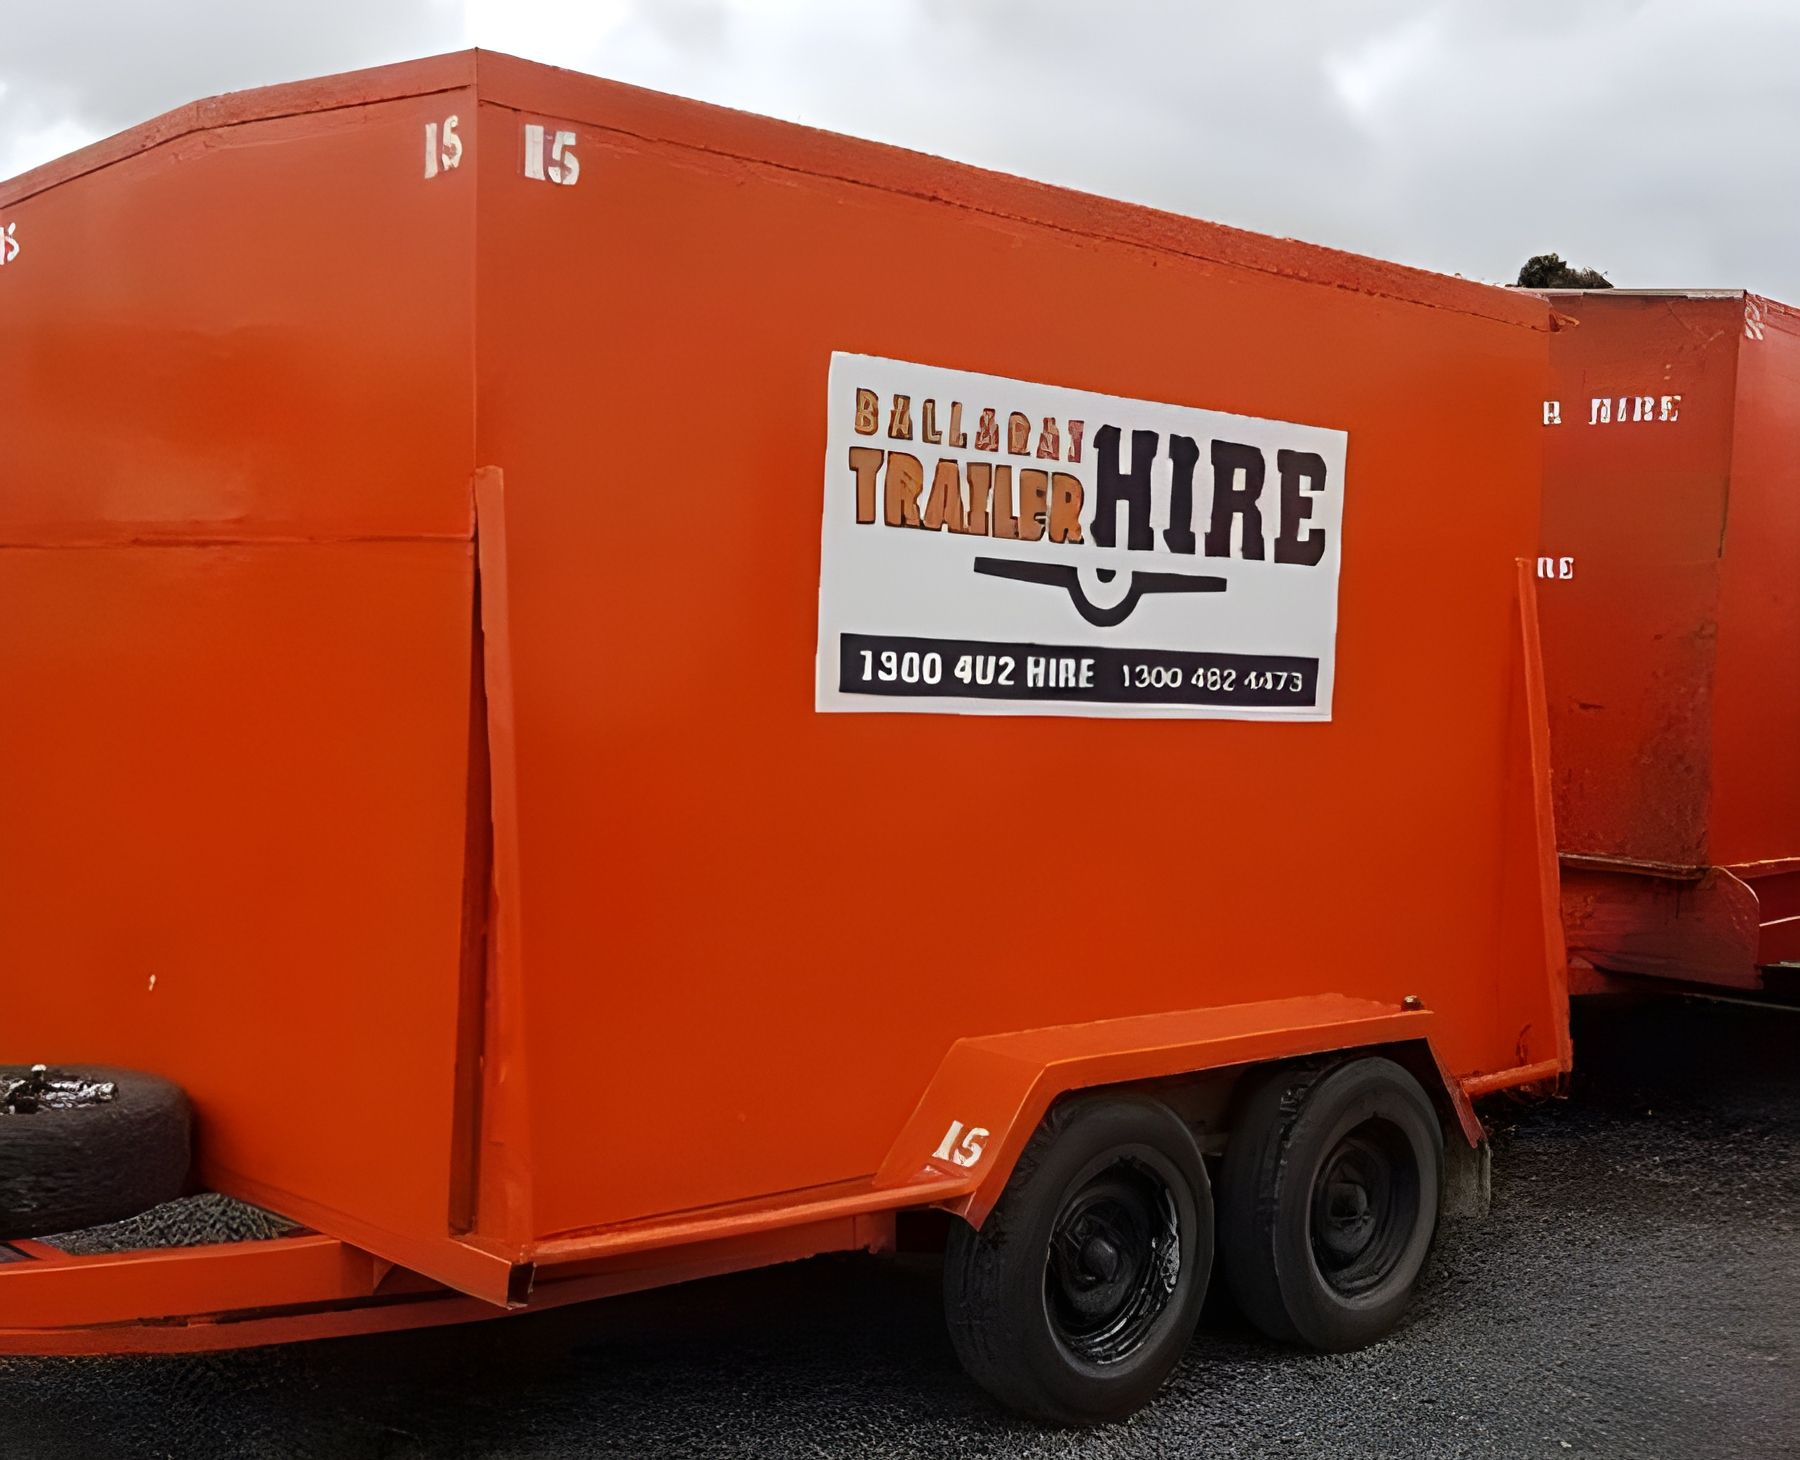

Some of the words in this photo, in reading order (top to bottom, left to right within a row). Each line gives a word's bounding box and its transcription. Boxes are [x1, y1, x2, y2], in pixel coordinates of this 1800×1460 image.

[425, 115, 463, 179] 15
[524, 123, 580, 186] 15
[848, 446, 1085, 545] TRAILER
[1093, 424, 1327, 567] HIRE
[953, 654, 1016, 686] 4U2
[1026, 655, 1096, 689] HIRE
[1122, 664, 1183, 688] 1300
[931, 1119, 991, 1168] 15
